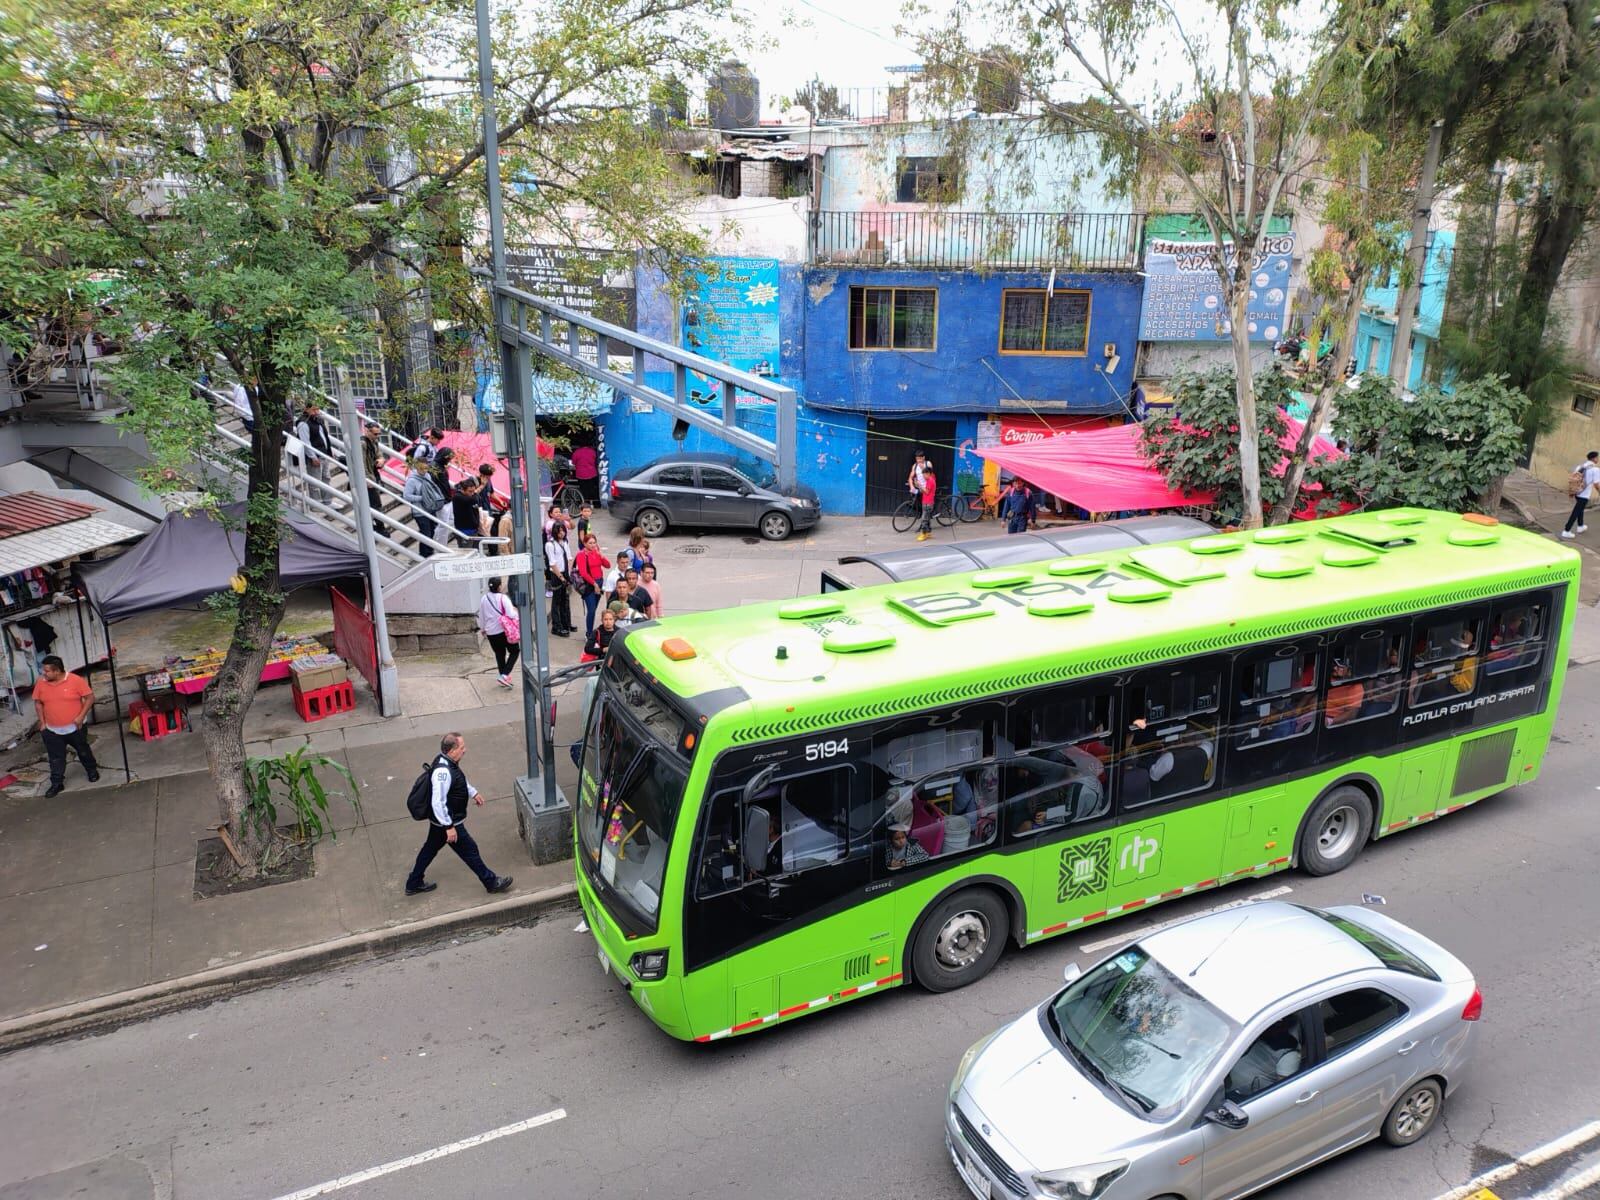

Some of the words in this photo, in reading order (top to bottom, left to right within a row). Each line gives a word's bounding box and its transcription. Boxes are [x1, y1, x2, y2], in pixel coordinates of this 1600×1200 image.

[1149, 292, 1200, 302] SOFTWARE
[1185, 311, 1198, 320] DE
[1249, 311, 1279, 321] GMAIL
[1145, 320, 1209, 329] ACCESORIOS
[1144, 329, 1197, 338] RECARGAS
[1402, 707, 1448, 727] FLOTILLA
[1449, 694, 1497, 714] EMILIANO
[1498, 684, 1536, 701] ZAPATA
[805, 738, 849, 761] 5194
